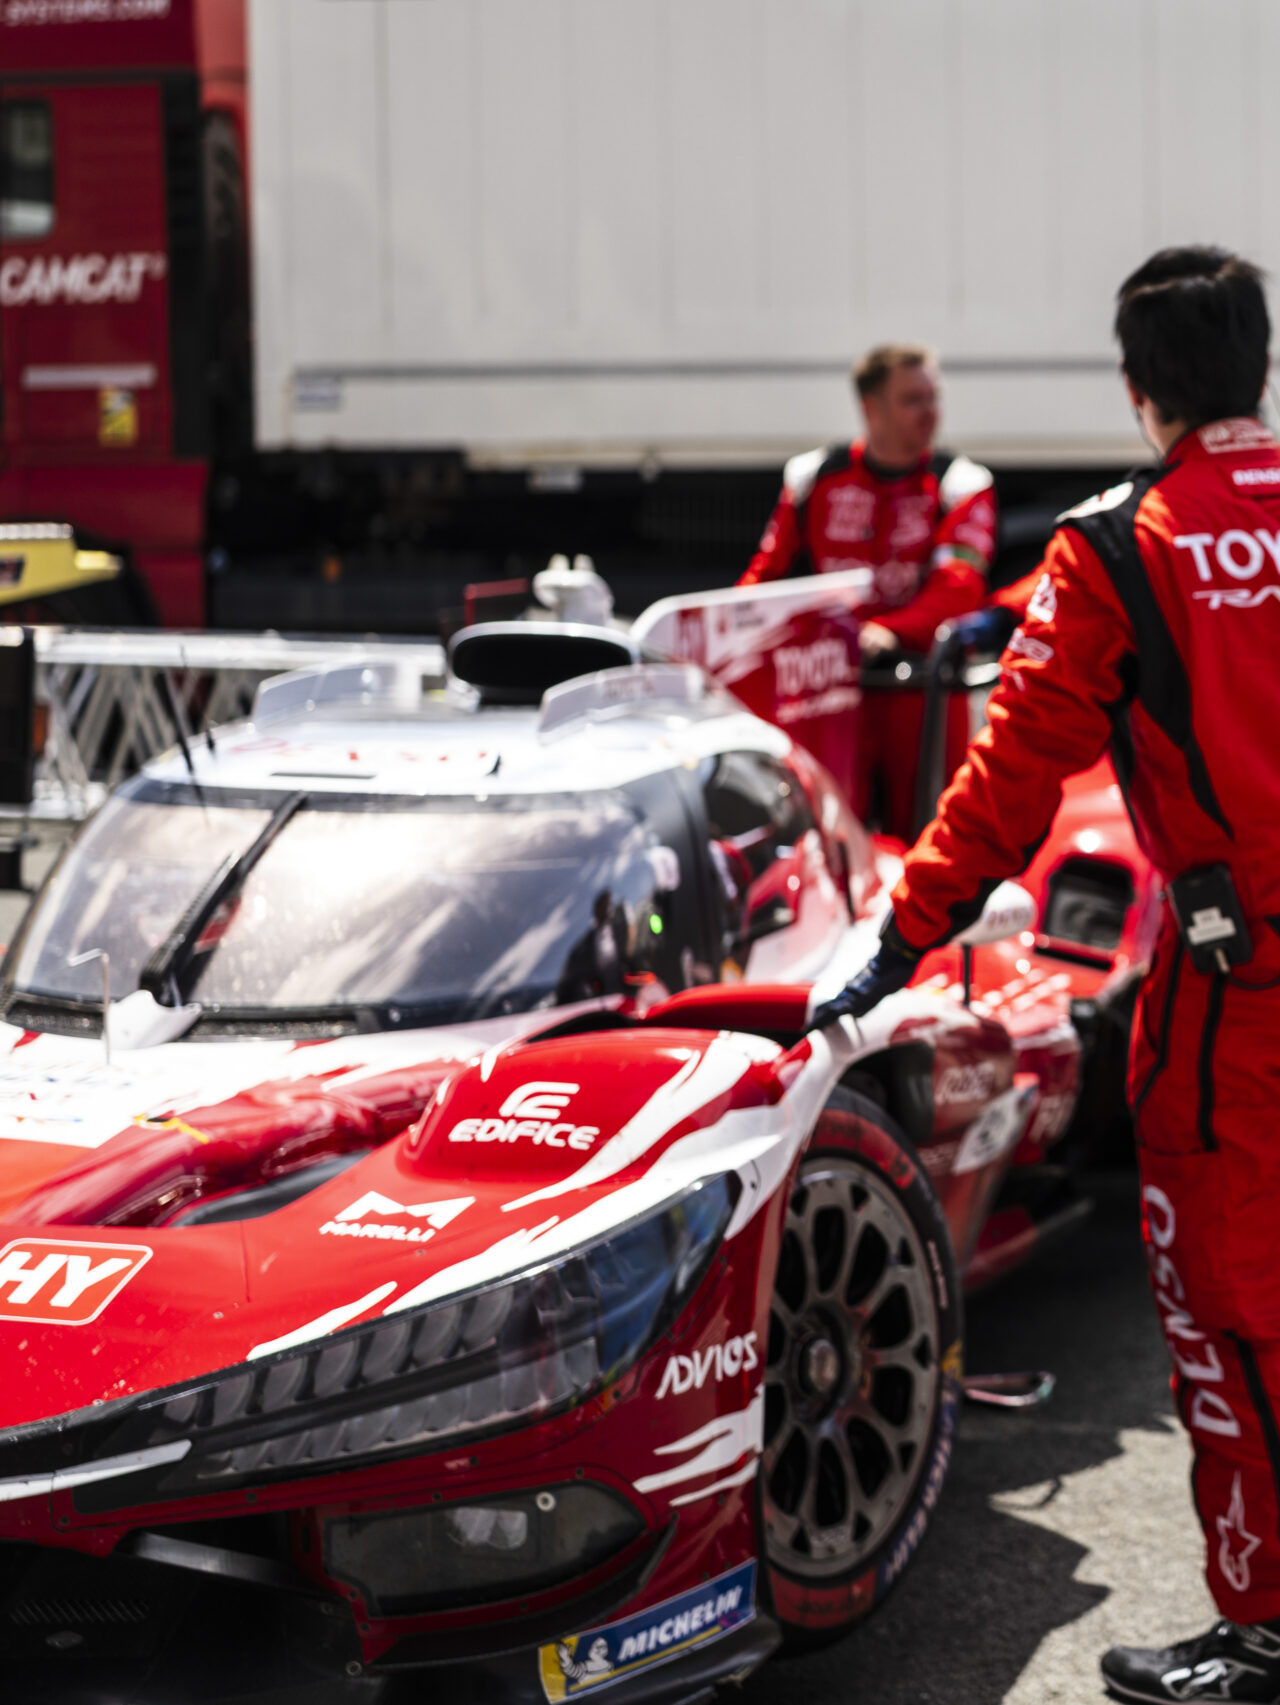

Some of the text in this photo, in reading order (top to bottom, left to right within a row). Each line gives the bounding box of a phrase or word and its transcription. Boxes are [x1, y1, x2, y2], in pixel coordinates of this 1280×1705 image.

[448, 1118, 600, 1150] EDIFICE
[318, 1221, 436, 1243] MARELLI
[1143, 1184, 1241, 1438] DENSO
[617, 1585, 743, 1662] MICHELIN
